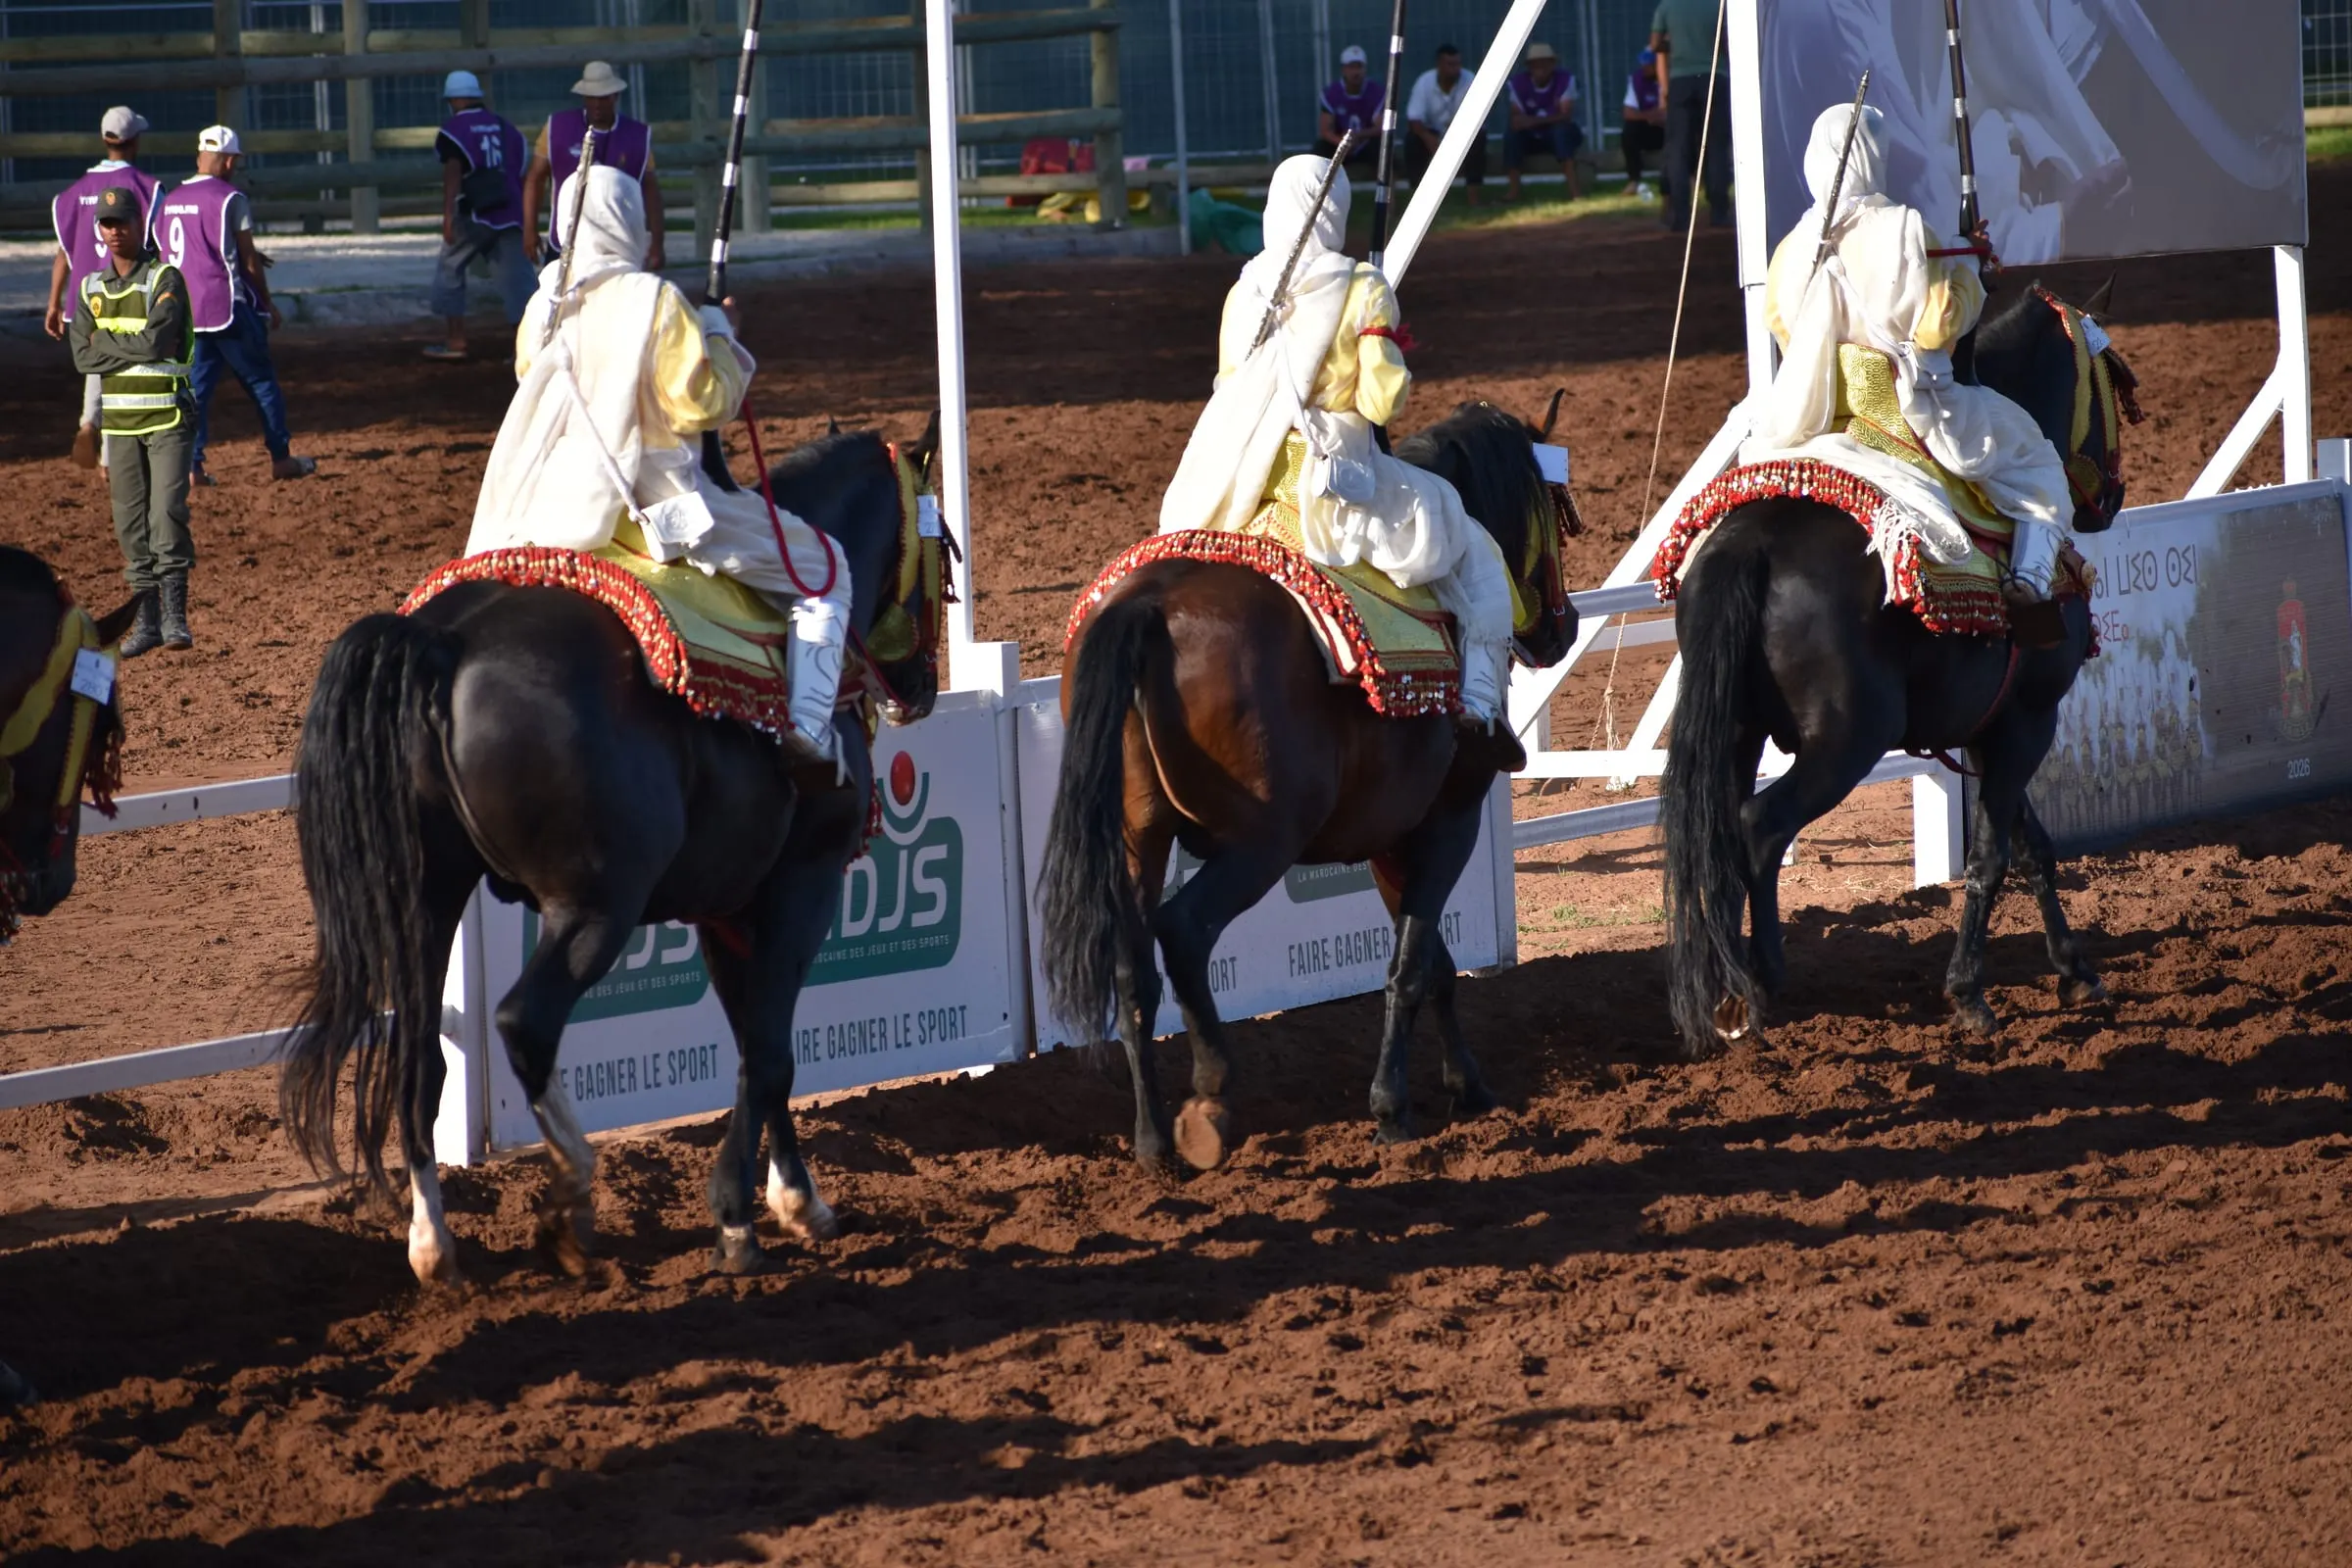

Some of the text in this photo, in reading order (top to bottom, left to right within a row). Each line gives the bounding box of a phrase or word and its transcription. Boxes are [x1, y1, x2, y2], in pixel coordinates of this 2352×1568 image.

[168, 217, 185, 270] 9
[2287, 758, 2311, 779] 2026
[825, 844, 949, 941] DJS
[849, 945, 864, 958] DES
[866, 942, 887, 956] JEUX
[889, 941, 900, 954] ET
[902, 938, 917, 951] DES
[919, 934, 950, 949] SPORTS
[1288, 938, 1330, 978] FAIRE
[1335, 926, 1392, 968] GAGNER
[597, 984, 612, 997] DES
[614, 981, 635, 994] JEUX
[638, 978, 649, 991] ET
[651, 976, 667, 989] DES
[669, 971, 701, 986] SPORTS
[1209, 956, 1238, 994] ORT
[796, 1004, 968, 1065] IRE GAGNER LE SPORT
[574, 1056, 638, 1102] GAGNER
[643, 1053, 662, 1091] LE
[667, 1043, 718, 1086] SPORT
